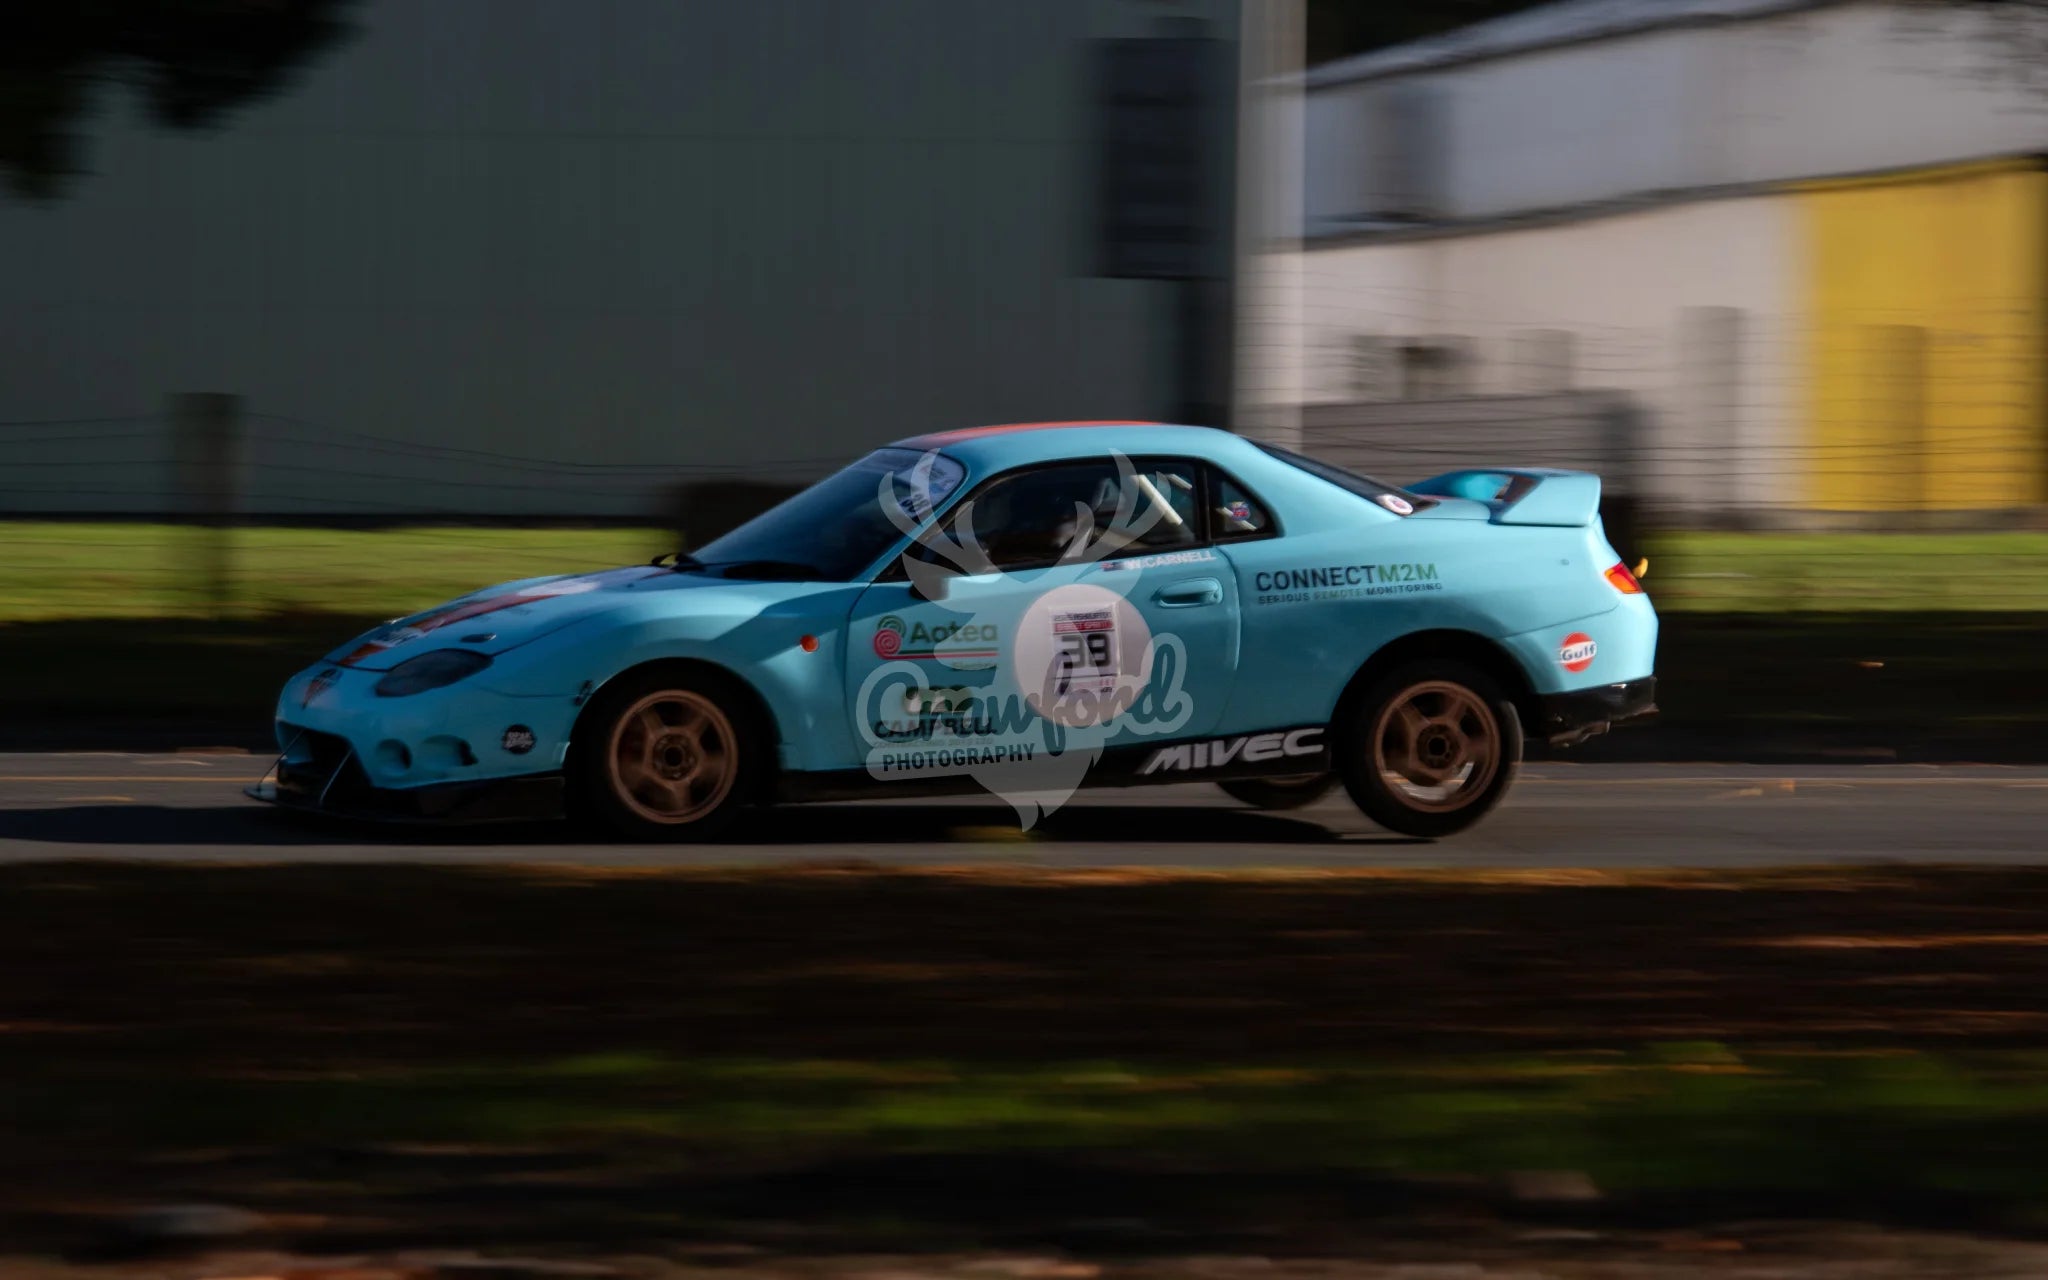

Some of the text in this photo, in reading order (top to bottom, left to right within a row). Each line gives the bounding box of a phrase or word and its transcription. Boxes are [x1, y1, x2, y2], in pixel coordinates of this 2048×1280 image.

[1256, 563, 1439, 591] CONNECTM2M
[1258, 582, 1442, 605] SERIOUS REMOTE MONITORING
[909, 621, 998, 643] Aotea
[1562, 643, 1596, 661] Gulf
[874, 716, 997, 738] CAMPBELL
[1143, 727, 1325, 775] MIVEC
